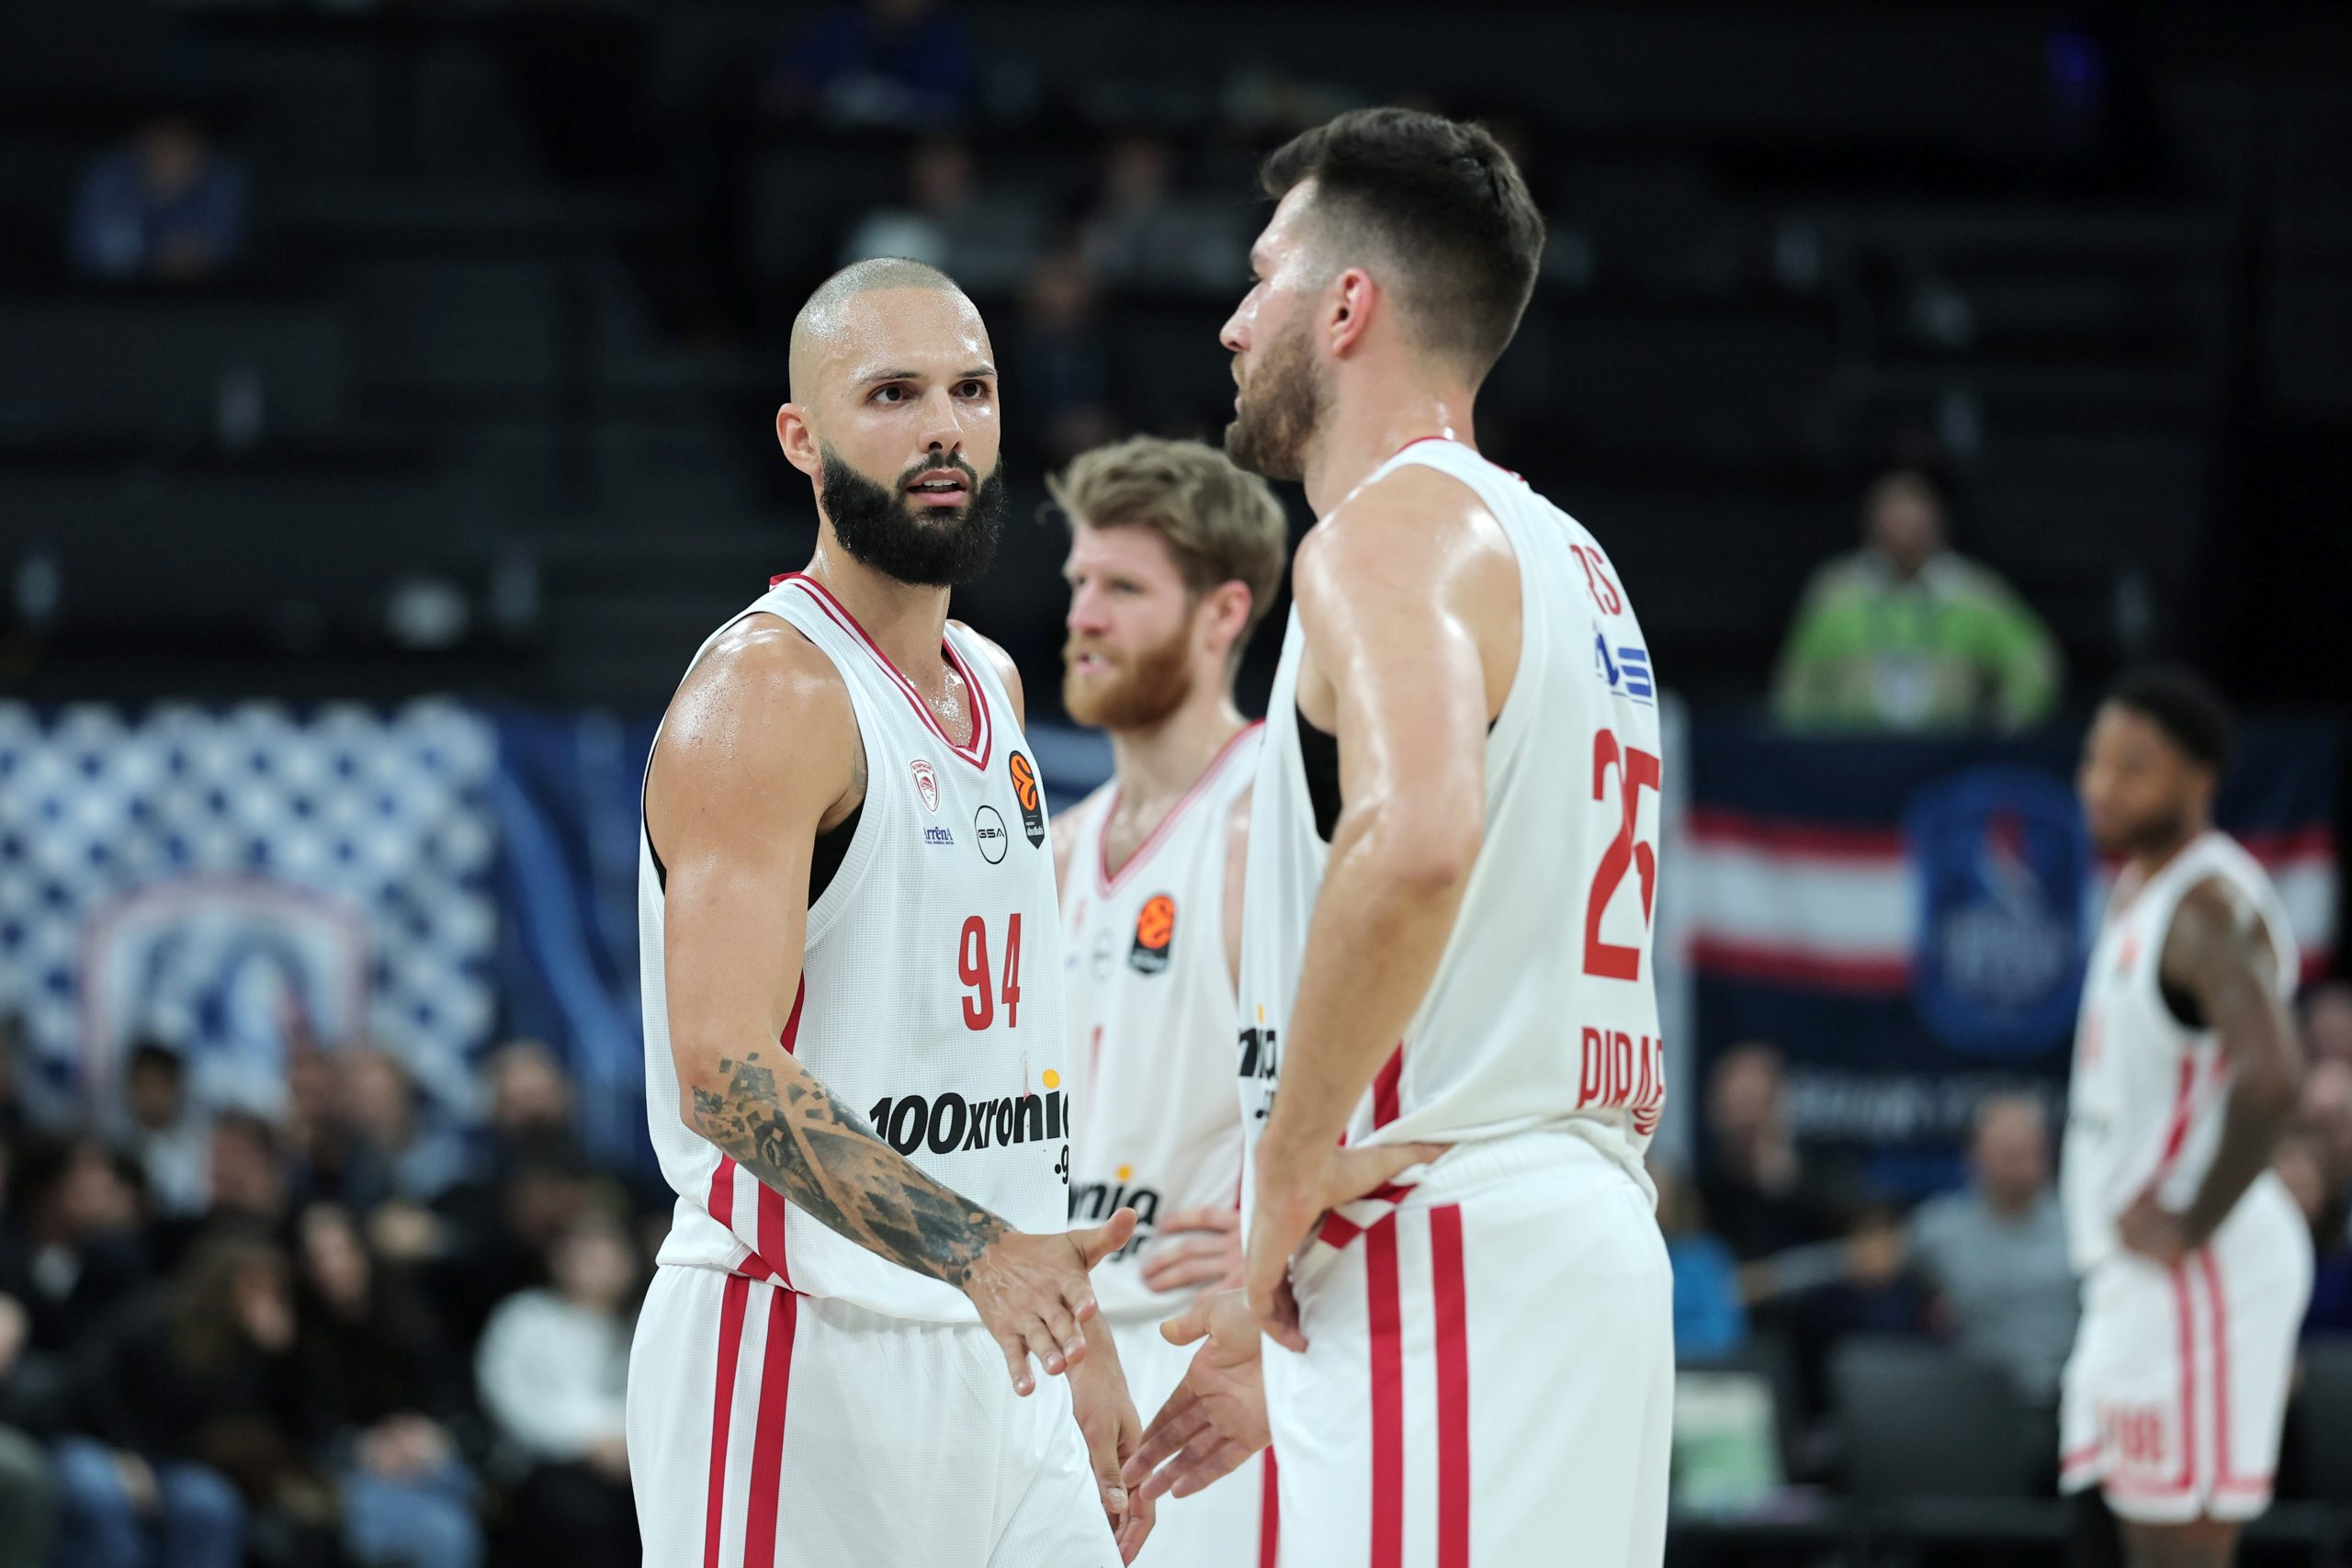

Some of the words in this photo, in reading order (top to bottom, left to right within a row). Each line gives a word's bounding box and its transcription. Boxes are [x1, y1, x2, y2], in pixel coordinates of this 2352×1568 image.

[978, 828, 1005, 839] GSA
[1583, 728, 1660, 981] 25
[958, 913, 1022, 1031] 94
